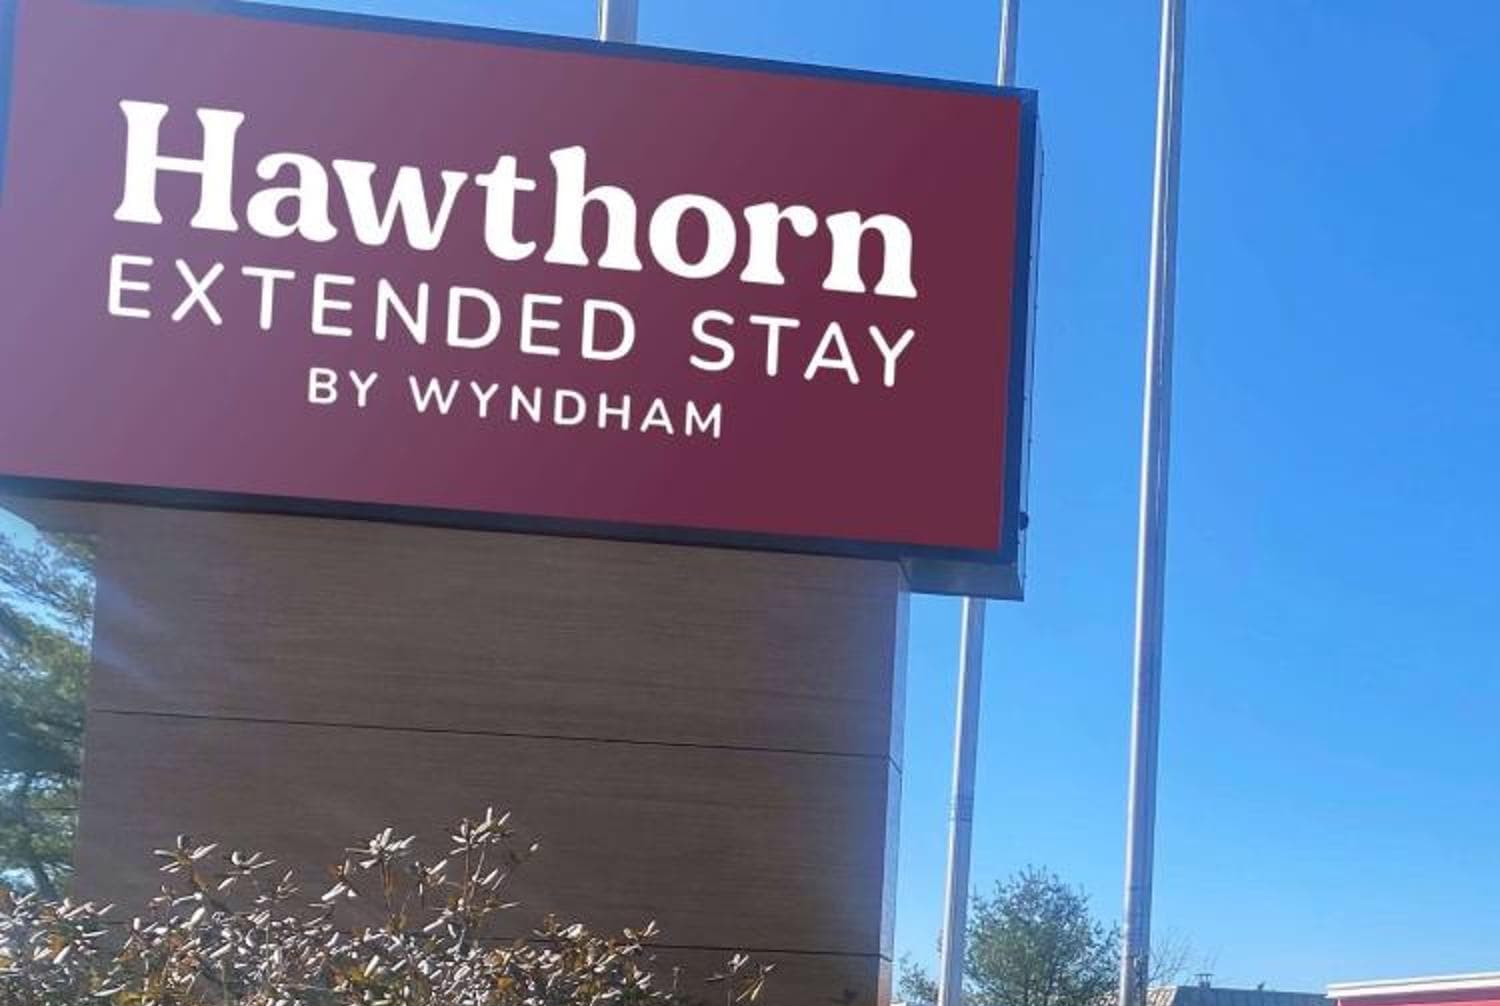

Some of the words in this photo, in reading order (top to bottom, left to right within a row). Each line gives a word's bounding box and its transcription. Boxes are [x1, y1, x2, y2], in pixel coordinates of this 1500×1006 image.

[112, 99, 917, 300] Hawthorn
[107, 253, 636, 362] EXTENDED
[689, 309, 916, 388] STAY
[308, 367, 379, 407] BY
[408, 375, 723, 438] WYNDHAM
